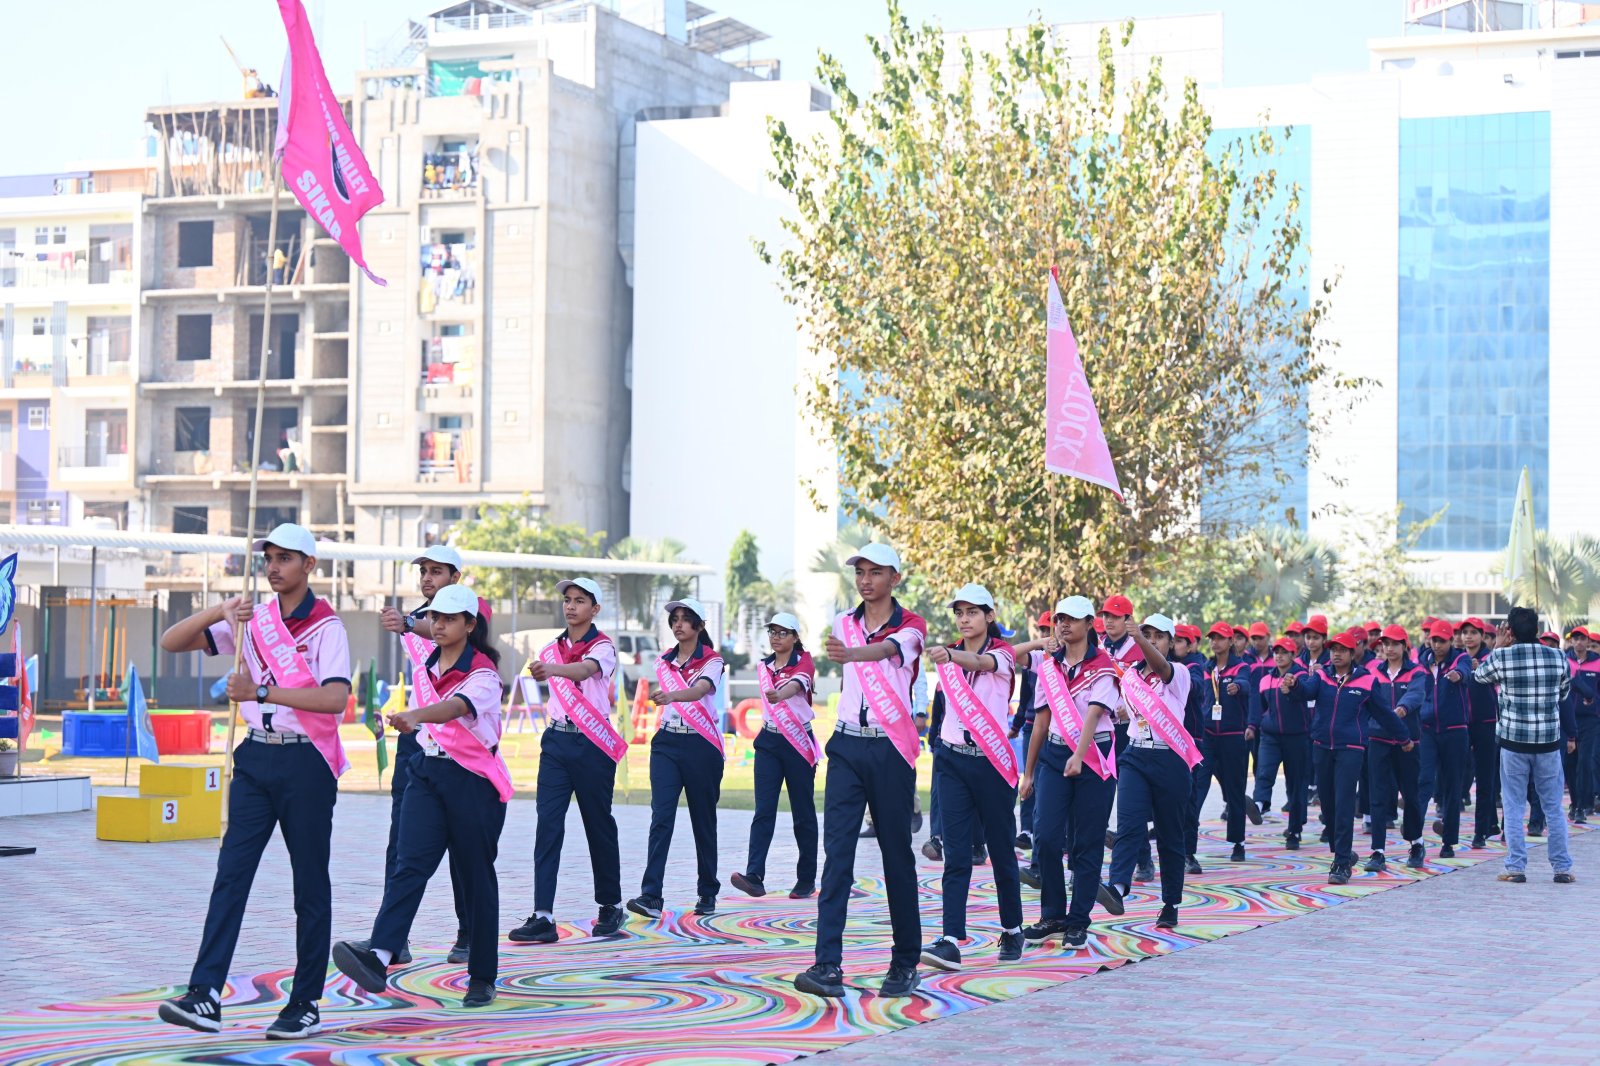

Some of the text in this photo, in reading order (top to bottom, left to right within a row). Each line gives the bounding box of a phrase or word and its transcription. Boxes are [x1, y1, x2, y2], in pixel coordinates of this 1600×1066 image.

[335, 144, 370, 195] VALLEY
[296, 169, 342, 242] SIKAR
[271, 642, 300, 677] BOY
[660, 665, 680, 693] LINGU
[543, 648, 617, 752] DISPLINE INCHARGE
[861, 665, 902, 725] CAPTAIN
[943, 661, 1013, 772] ISCIPLINE INCHARGE
[1042, 660, 1083, 747] LINGUA INCHARG
[774, 707, 811, 752] INCHARGE
[1151, 707, 1189, 754] INCHARGE
[208, 771, 217, 788] 1
[165, 802, 175, 820] 3
